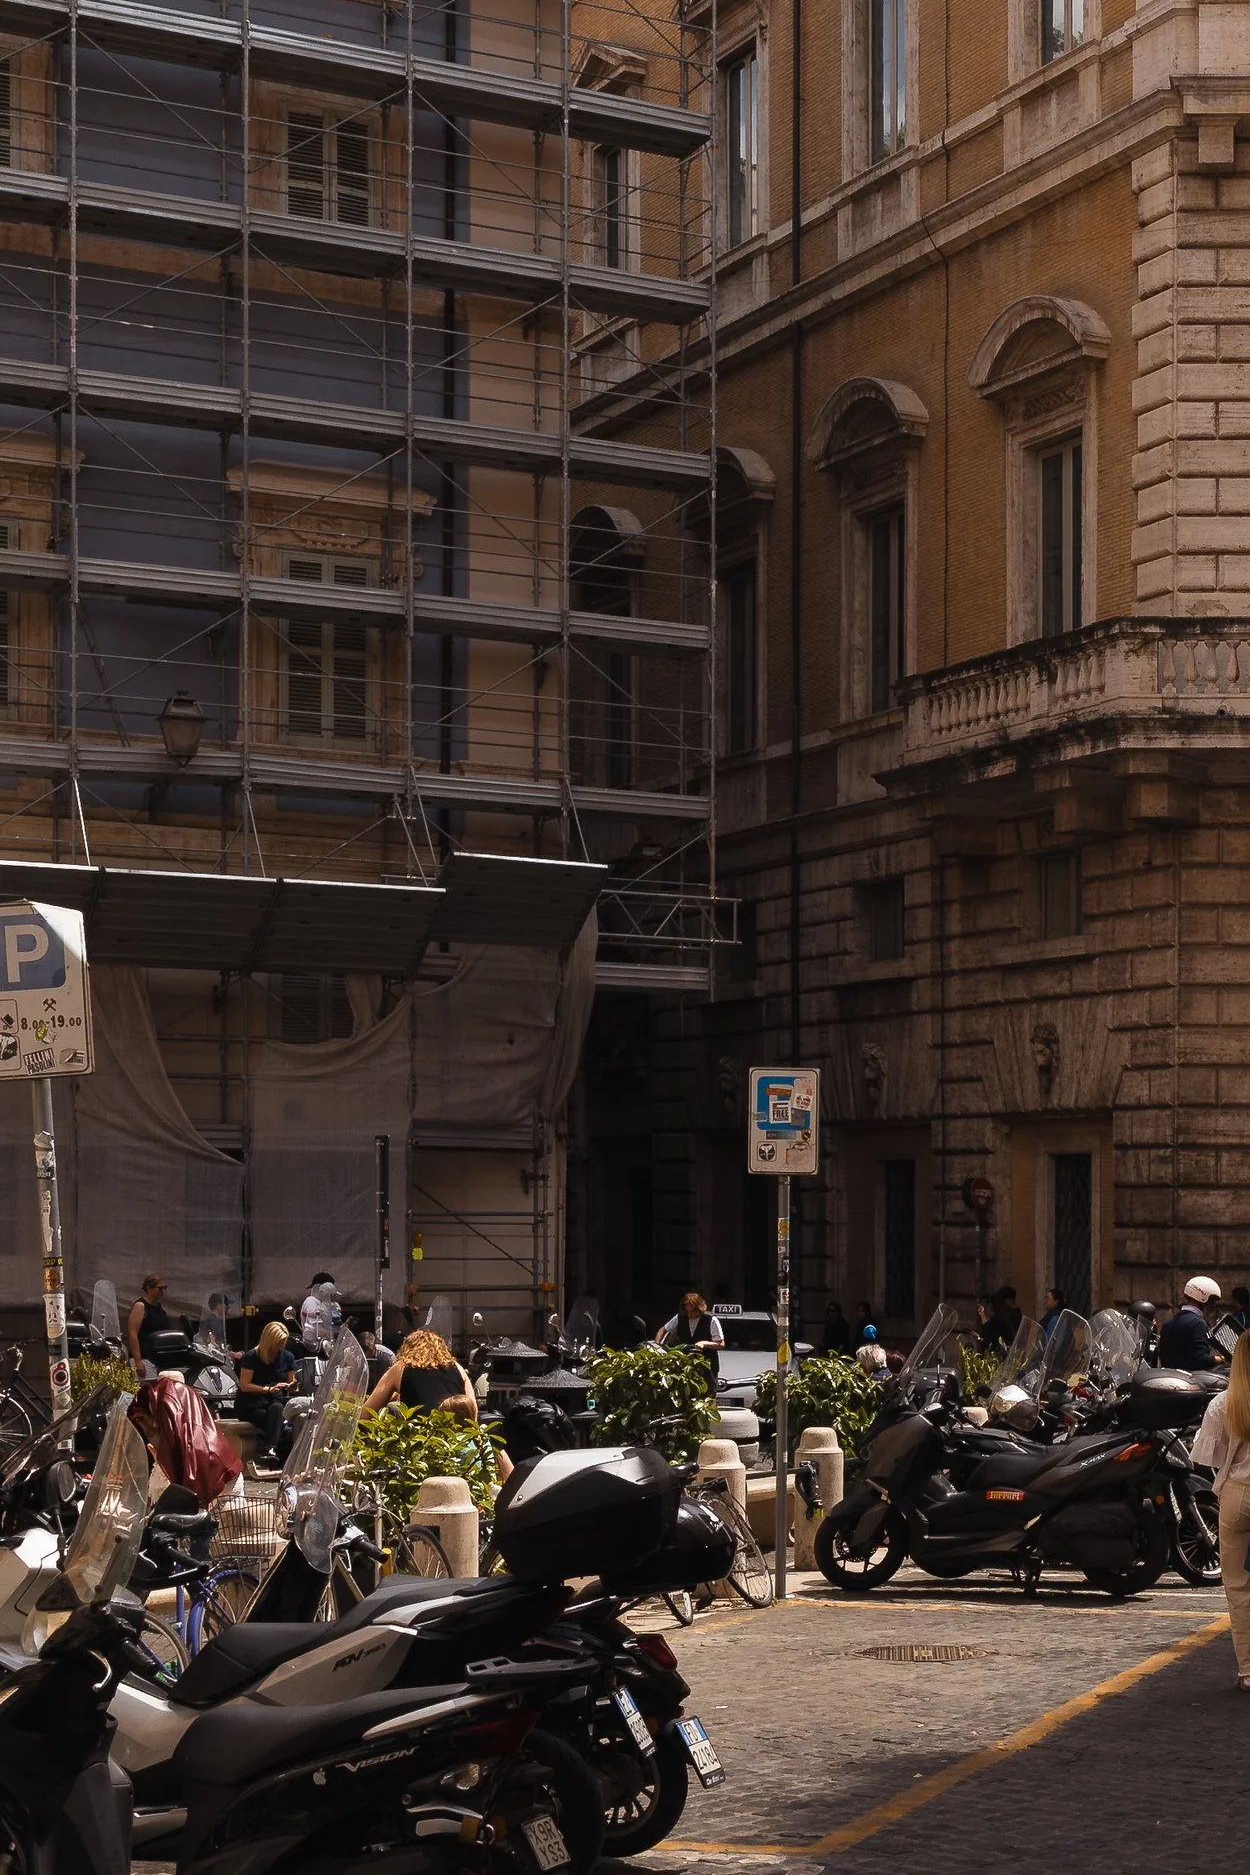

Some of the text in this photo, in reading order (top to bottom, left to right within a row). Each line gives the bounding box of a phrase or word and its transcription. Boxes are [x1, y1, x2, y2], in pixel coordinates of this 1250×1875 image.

[4, 924, 49, 983] P
[773, 1109, 789, 1118] FREE
[336, 1745, 421, 1773] VISION
[528, 1820, 558, 1846] X9R
[538, 1840, 567, 1866] YS3
